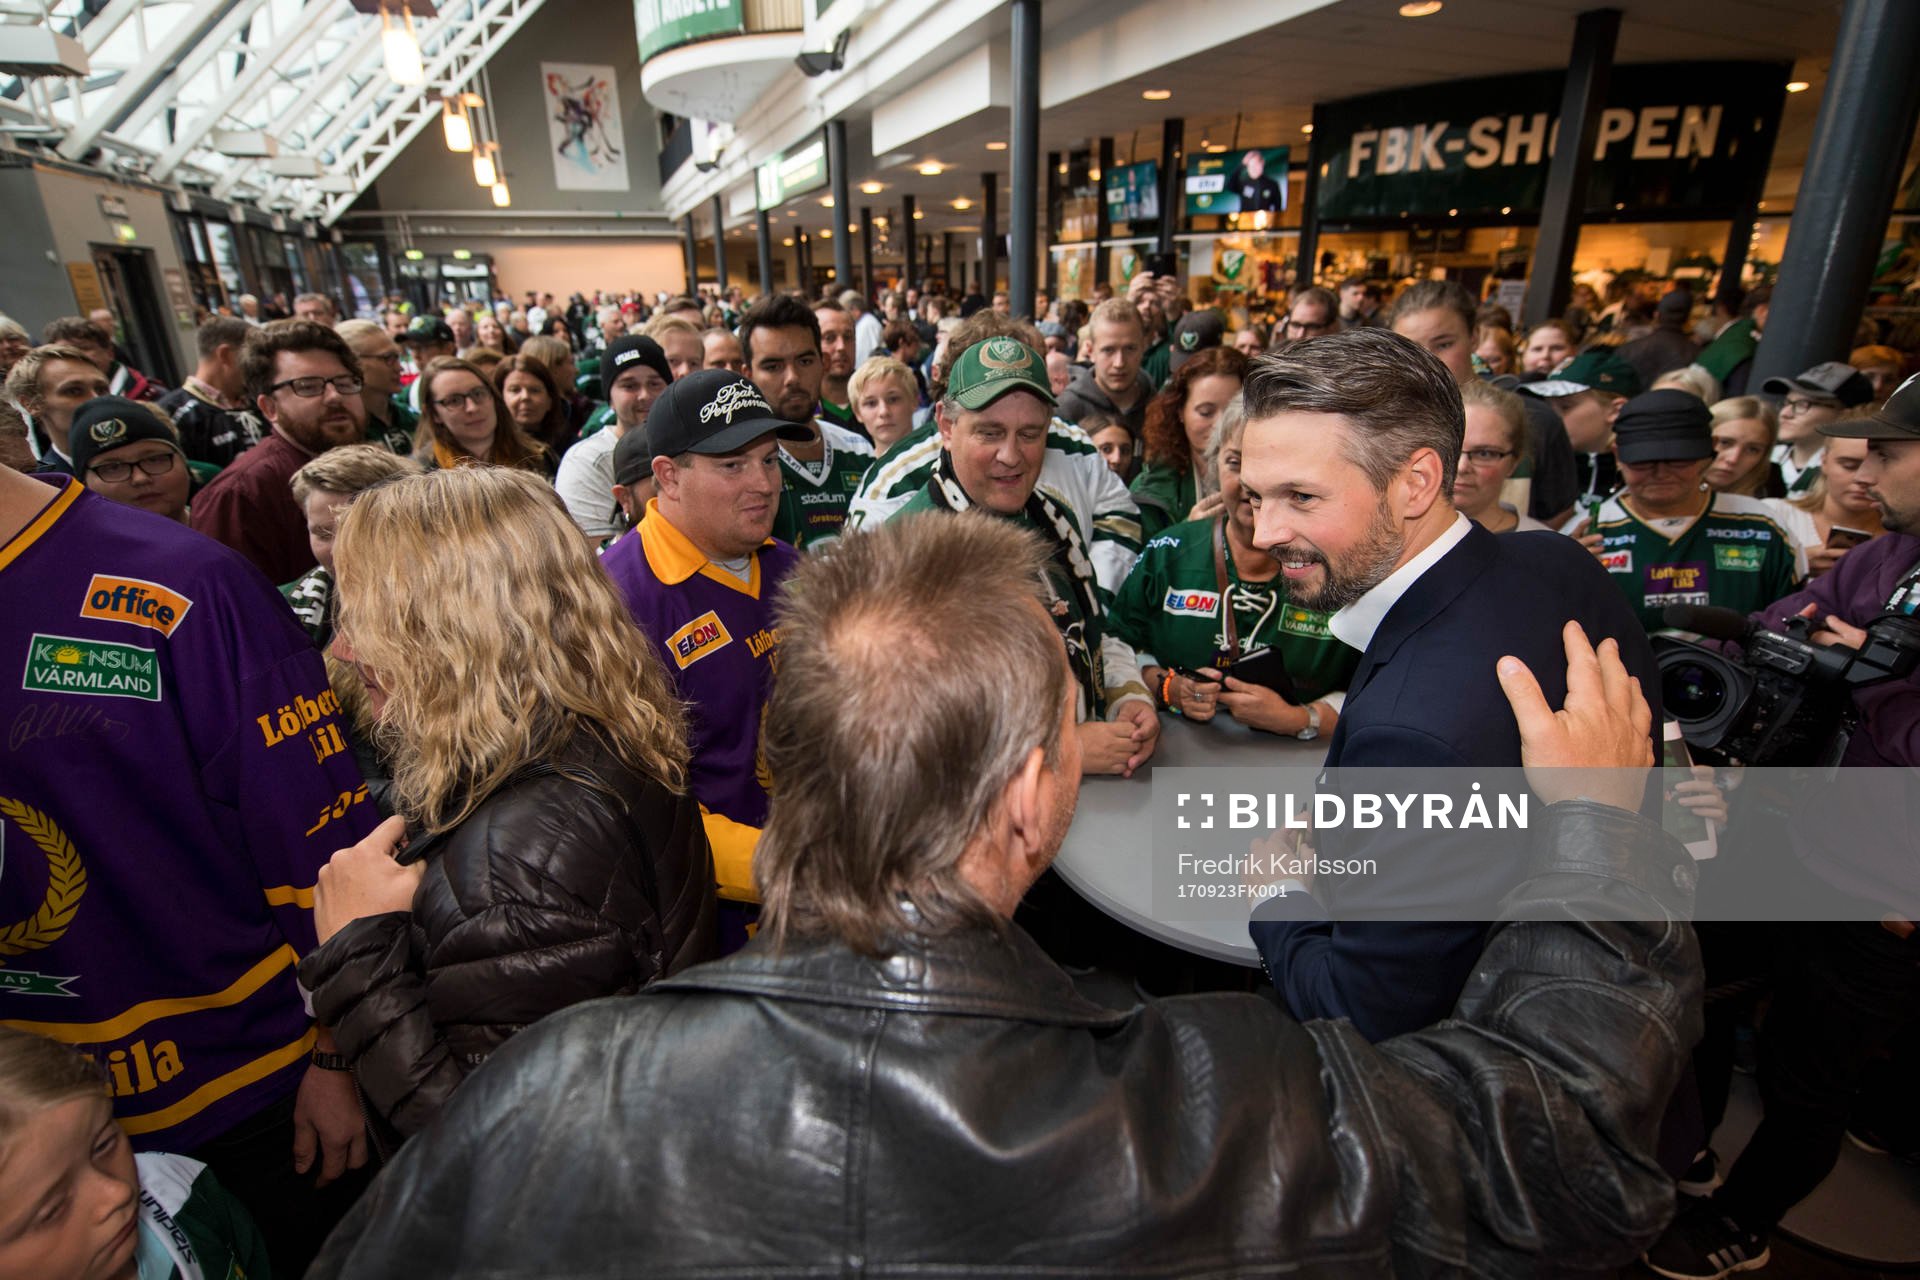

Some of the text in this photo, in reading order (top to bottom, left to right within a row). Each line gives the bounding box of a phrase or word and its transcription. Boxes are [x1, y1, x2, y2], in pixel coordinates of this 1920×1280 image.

[1347, 105, 1723, 178] FBK-SHPEN
[801, 491, 846, 505] stadium
[91, 585, 175, 626] office
[1166, 593, 1217, 612] ELON
[676, 622, 720, 658] ELON
[33, 664, 152, 693] VÄRMLAND
[104, 1039, 184, 1097] ila
